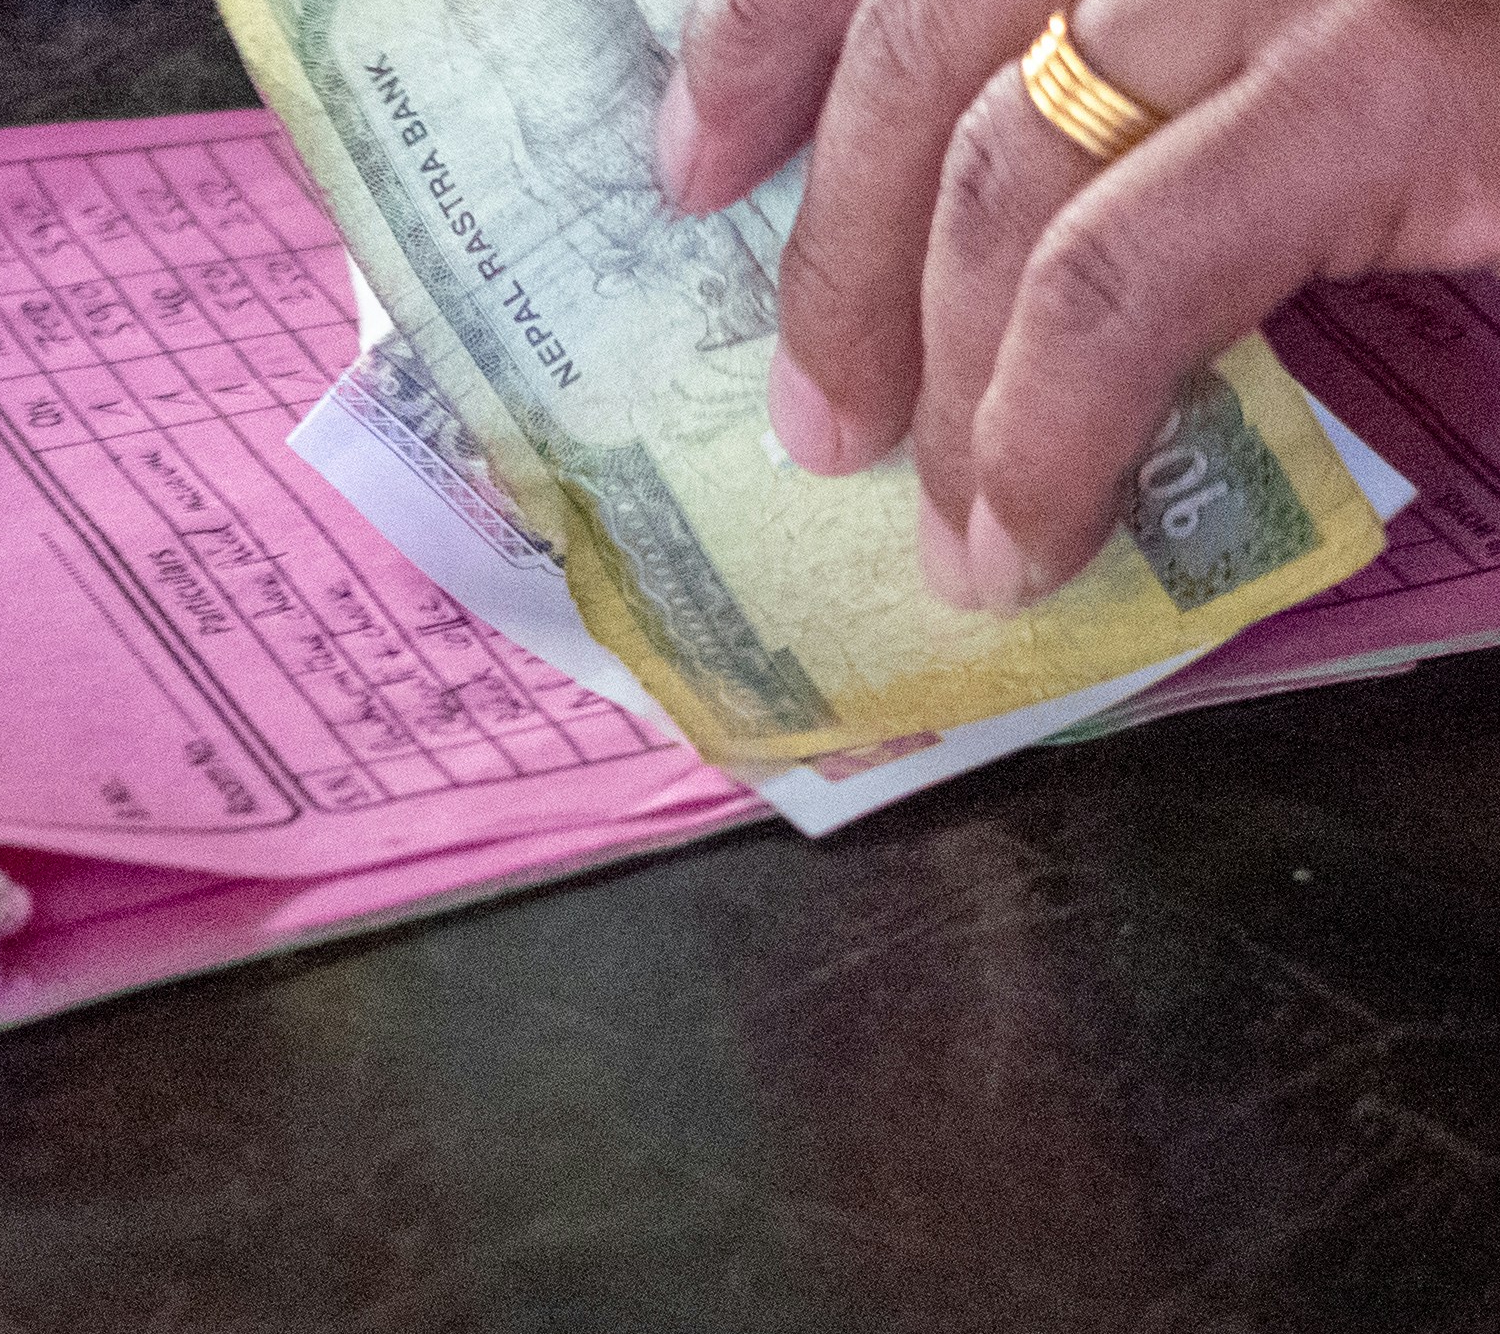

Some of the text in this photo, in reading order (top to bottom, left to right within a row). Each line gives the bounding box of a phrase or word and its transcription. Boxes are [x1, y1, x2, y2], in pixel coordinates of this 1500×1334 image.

[363, 51, 582, 388] NEPAL RASTRA BANK
[148, 551, 231, 635] Particulars
